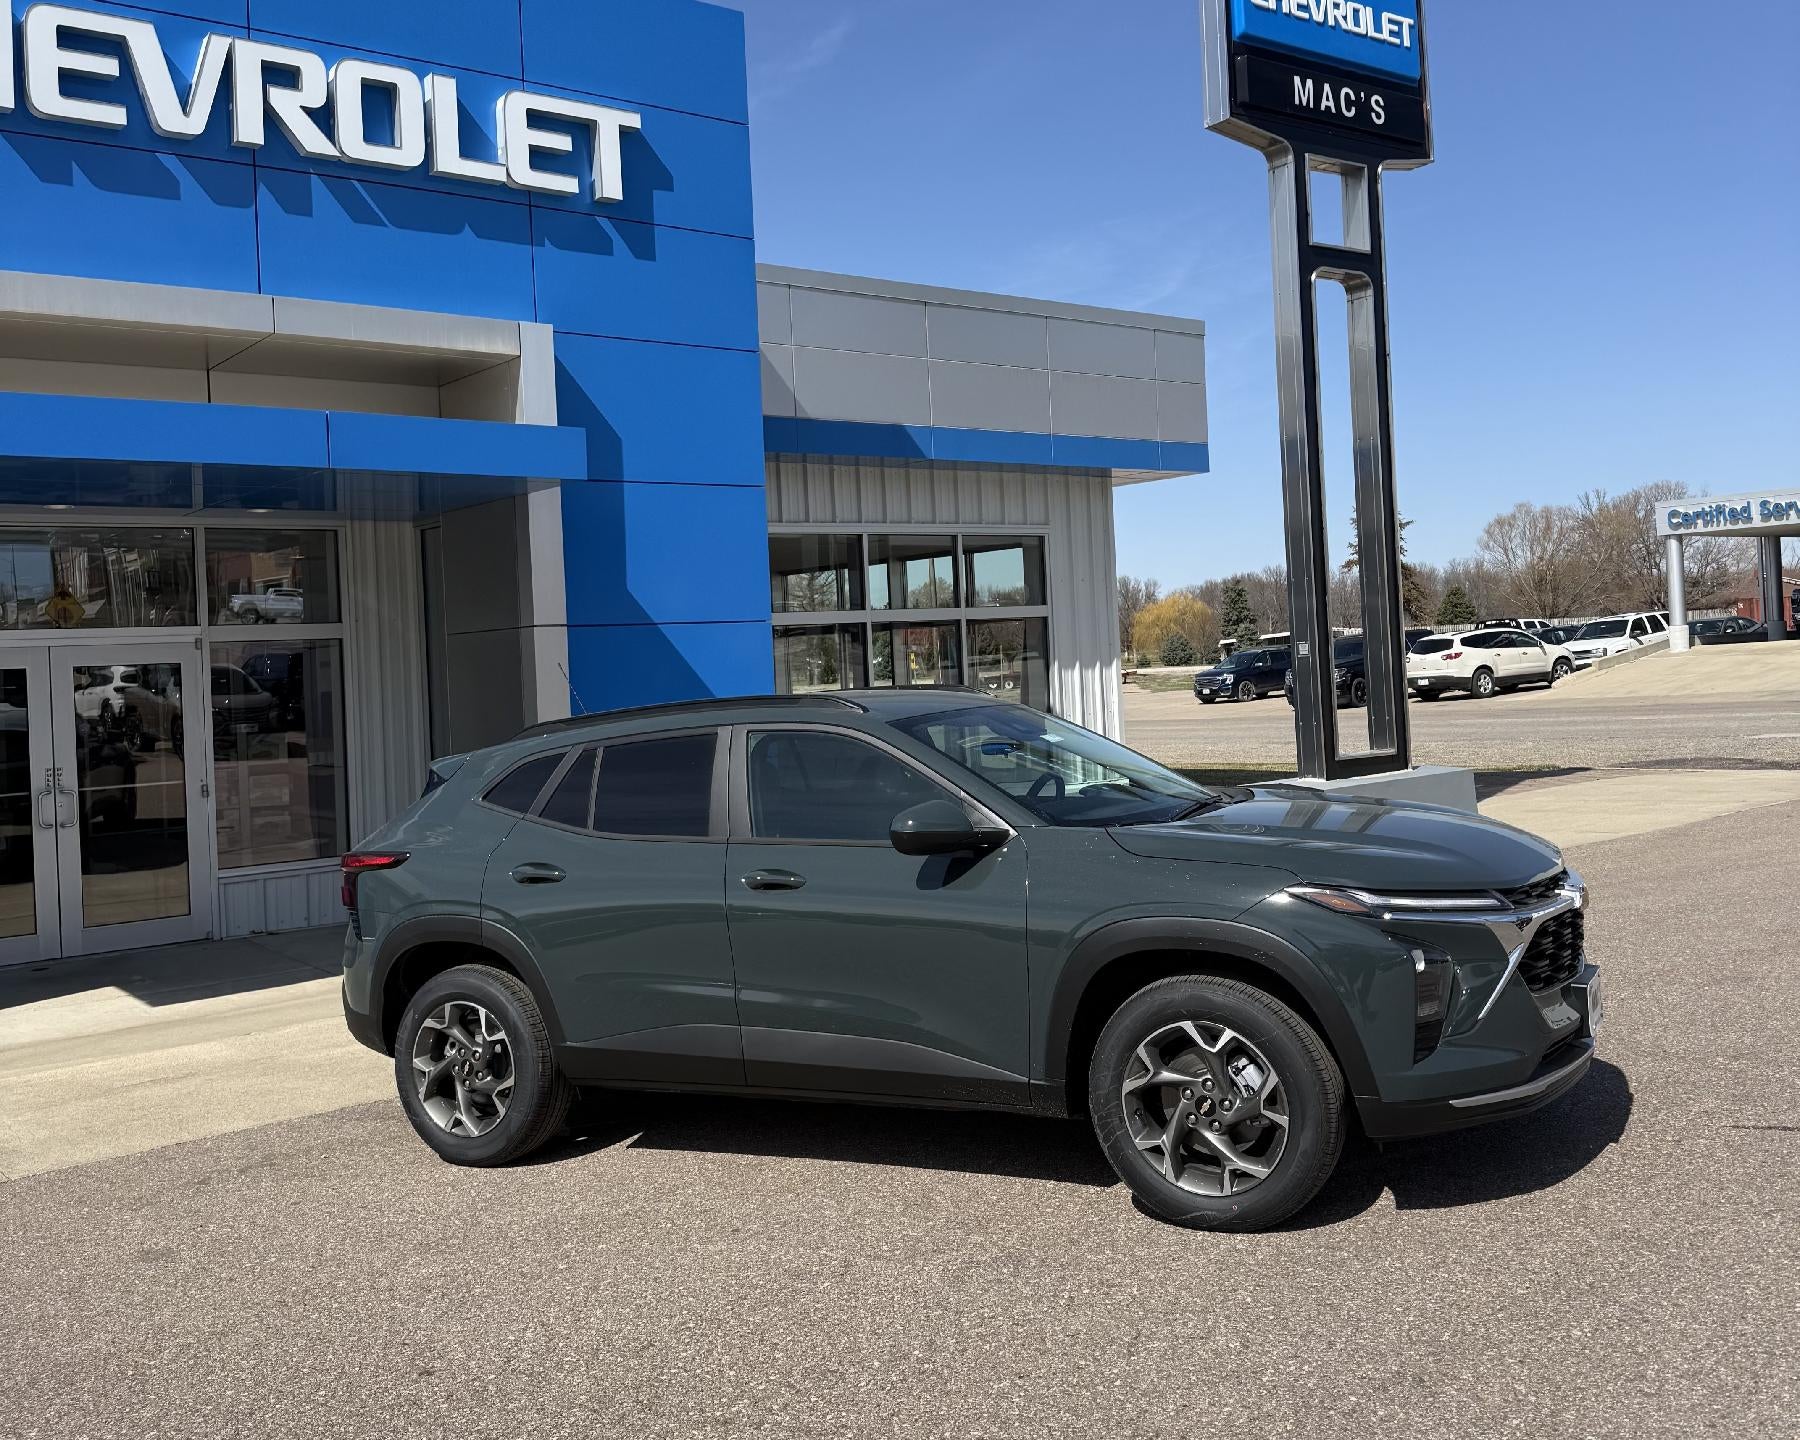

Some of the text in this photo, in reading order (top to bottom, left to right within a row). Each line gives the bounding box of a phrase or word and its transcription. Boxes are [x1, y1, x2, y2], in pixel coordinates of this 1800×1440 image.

[0, 0, 641, 204] EVROLET
[1293, 75, 1386, 125] MAC'S
[1667, 500, 1753, 530] Certified
